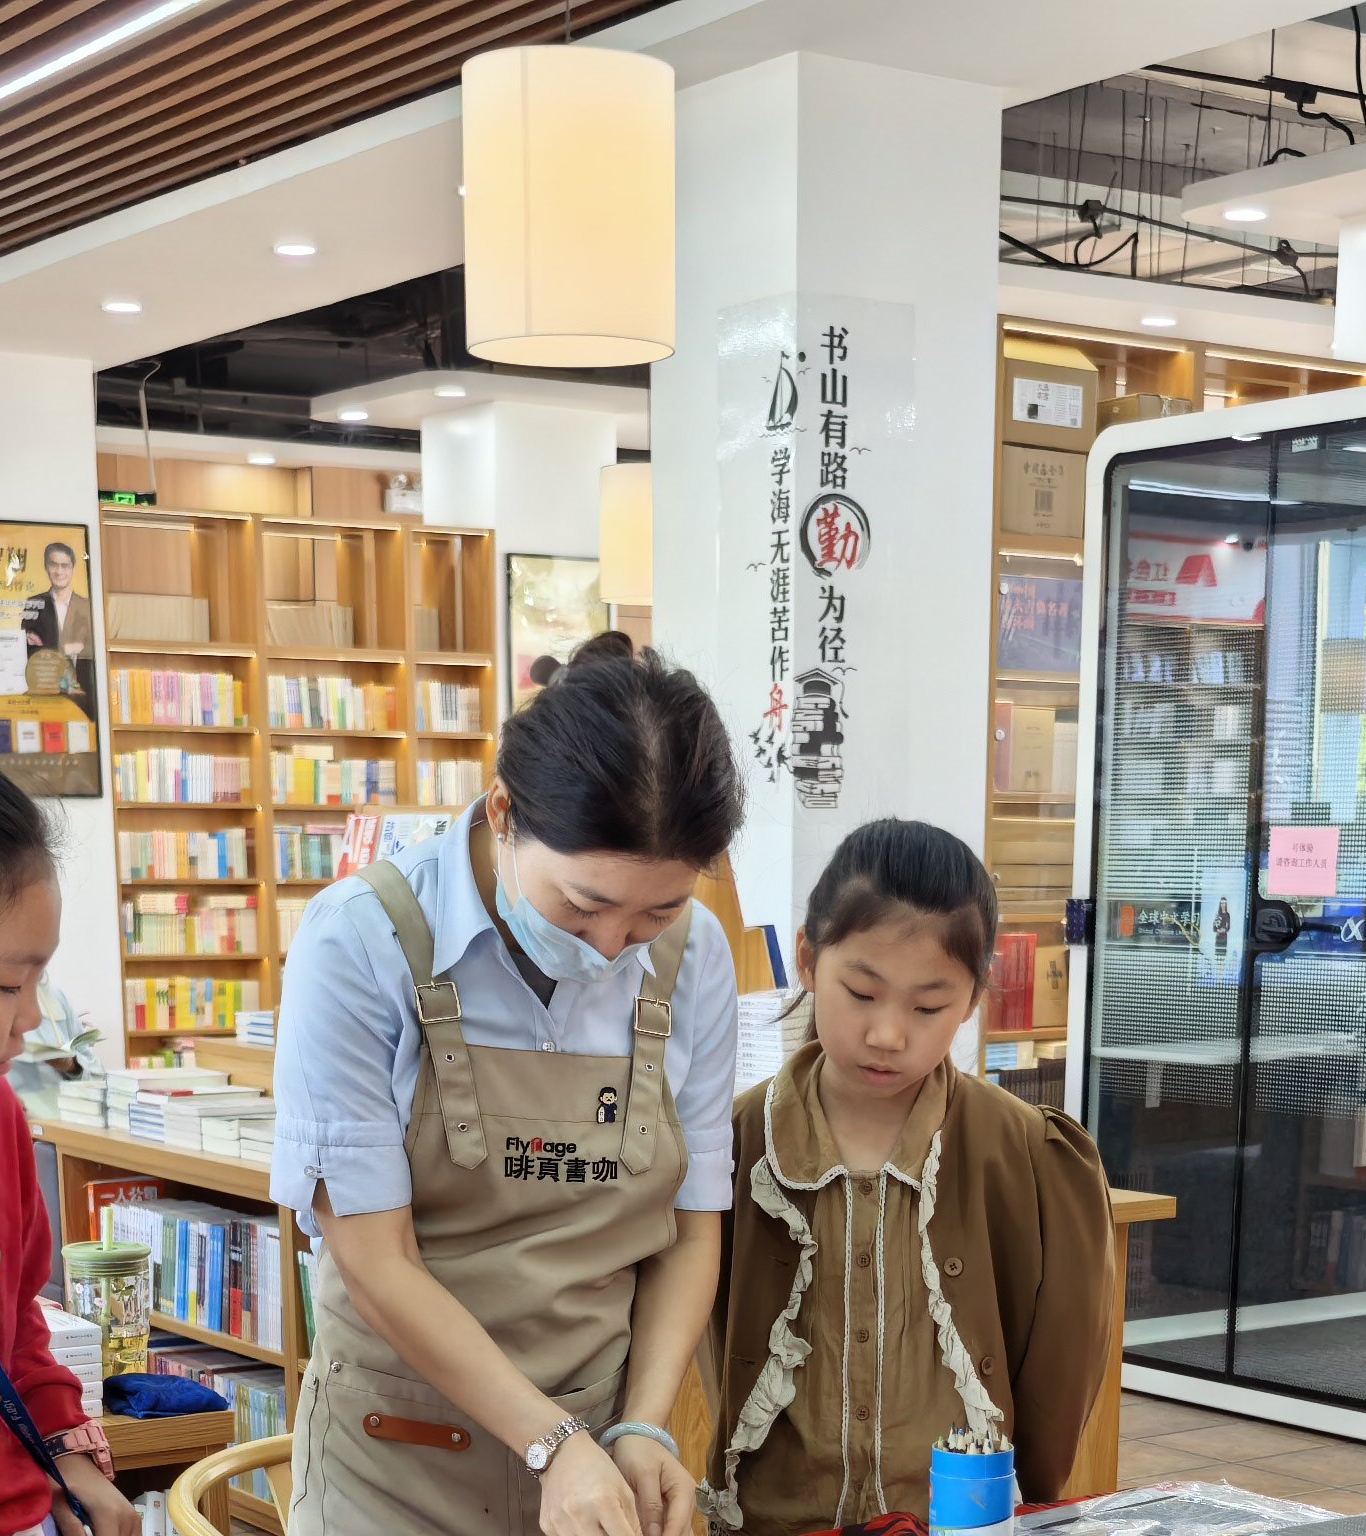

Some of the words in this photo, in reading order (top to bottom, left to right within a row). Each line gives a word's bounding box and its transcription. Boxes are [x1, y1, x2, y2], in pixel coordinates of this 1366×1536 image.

[816, 326, 859, 664] 书山有路勤为径
[763, 448, 790, 732] 学海无涯苦作舟
[1275, 857, 1328, 870] 请咨询工作人员
[504, 1154, 618, 1182] 啡頁書咖
